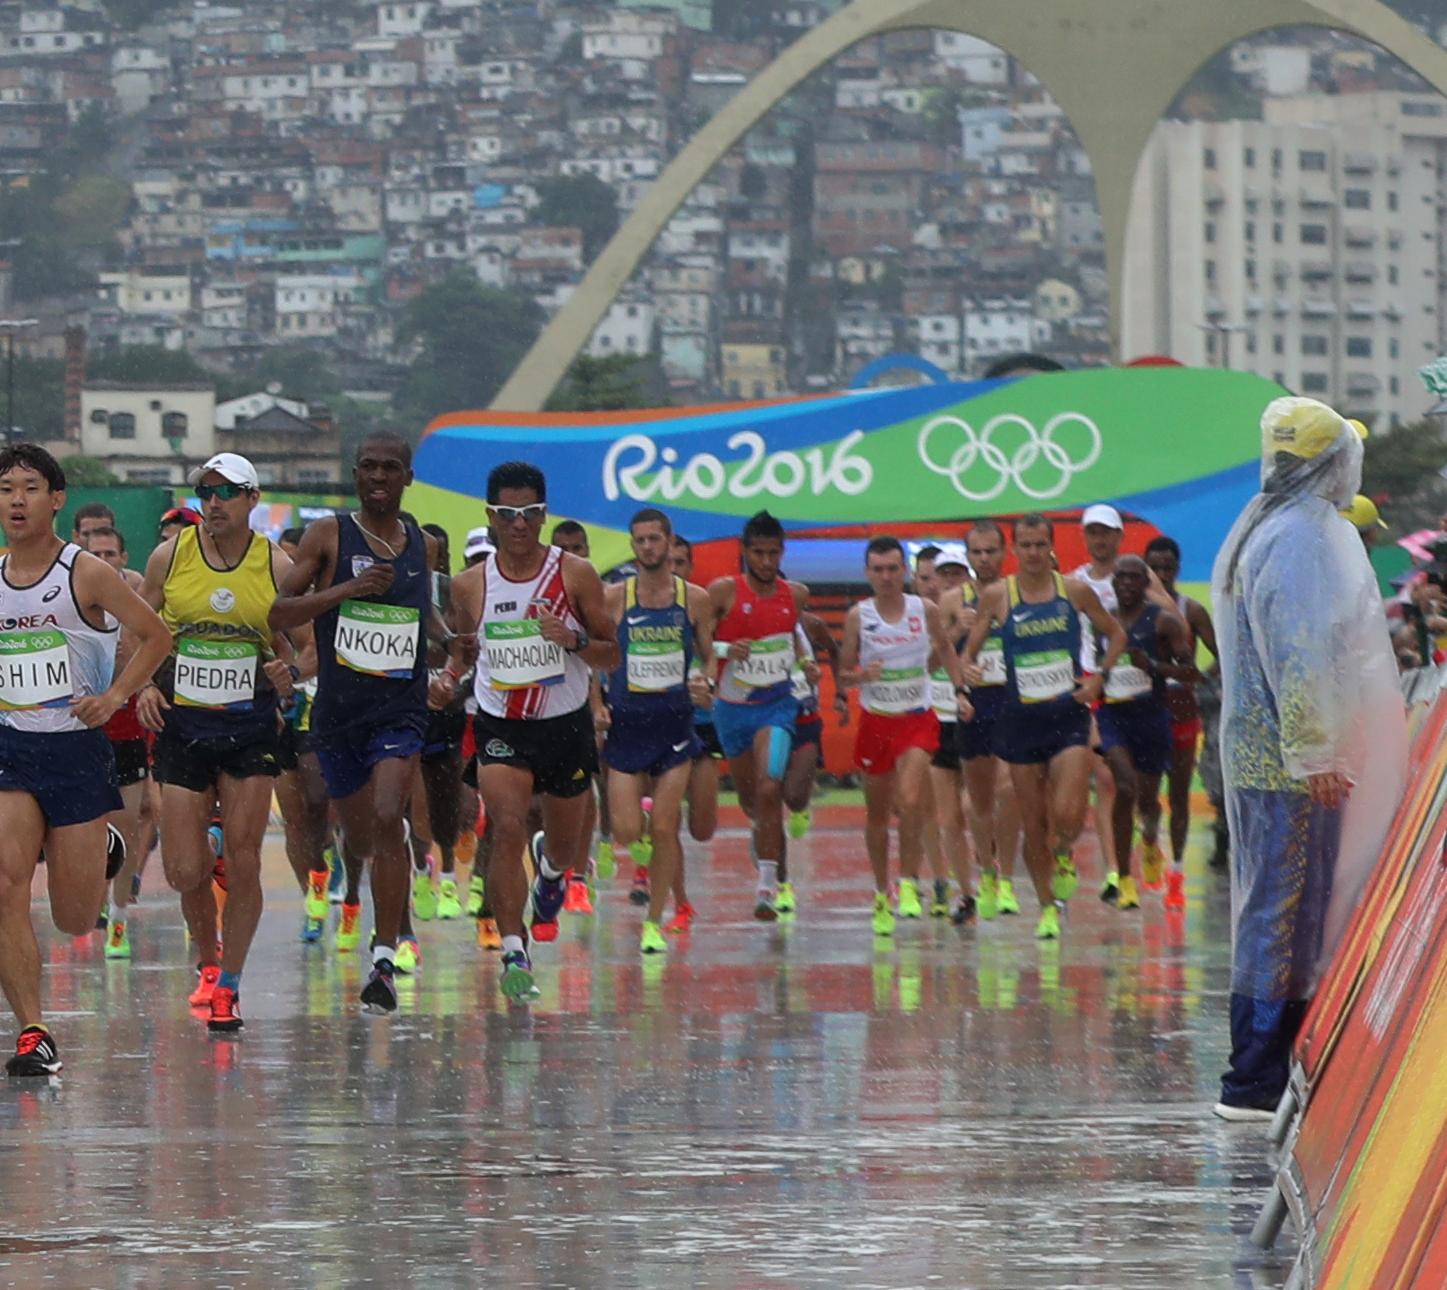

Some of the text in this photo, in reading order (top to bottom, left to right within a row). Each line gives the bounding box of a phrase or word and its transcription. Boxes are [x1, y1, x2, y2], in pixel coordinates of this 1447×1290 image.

[602, 429, 873, 501] Rio2016
[494, 600, 518, 614] PERU
[628, 626, 683, 643] UKRAINE
[1015, 615, 1068, 637] UKRAINE
[338, 626, 415, 658] NKOKA
[488, 643, 562, 670] MACHACUAY
[735, 657, 788, 675] AYALA
[177, 664, 253, 690] PIEDRA
